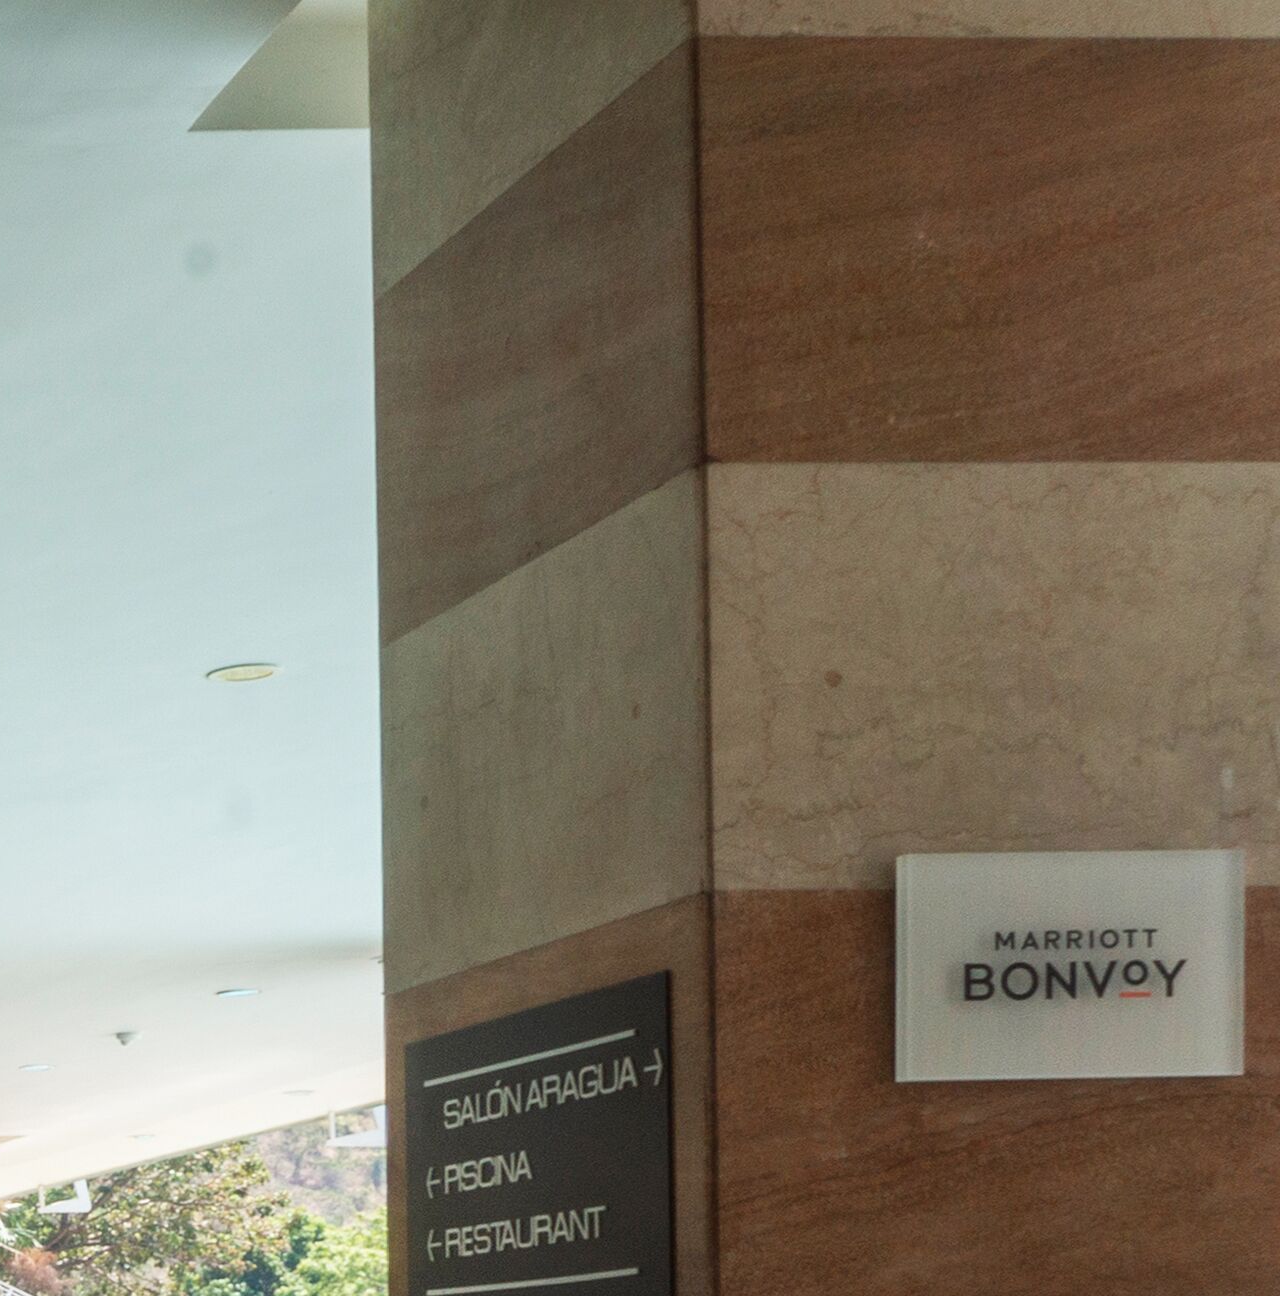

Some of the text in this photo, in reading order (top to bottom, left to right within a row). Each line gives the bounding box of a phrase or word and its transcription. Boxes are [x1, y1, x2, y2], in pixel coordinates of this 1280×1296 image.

[994, 928, 1159, 951] MARRIOTT
[963, 958, 1188, 1001] BONVOY
[443, 1055, 638, 1130] SALÓN ARAGUA
[443, 1150, 533, 1195] PISCINA
[444, 1205, 607, 1259] RESTAURANT
